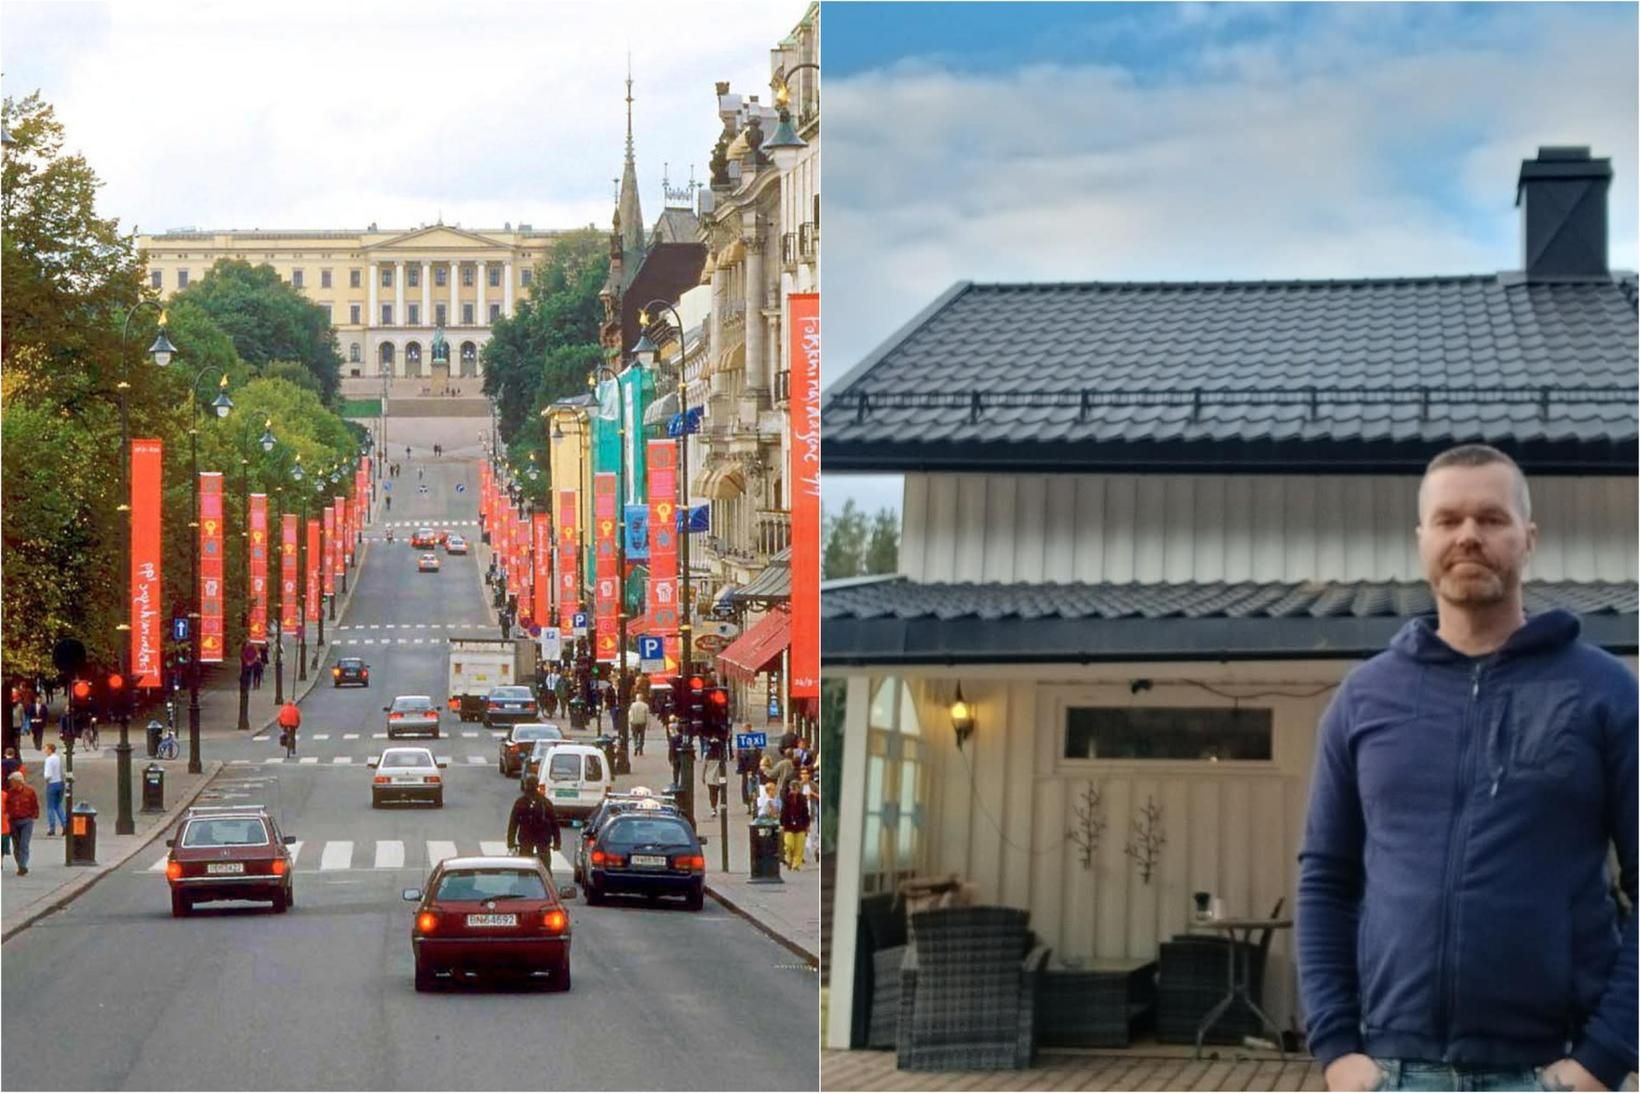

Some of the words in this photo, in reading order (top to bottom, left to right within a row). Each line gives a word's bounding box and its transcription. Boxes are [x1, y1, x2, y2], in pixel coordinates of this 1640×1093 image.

[576, 614, 585, 627] P
[645, 639, 658, 658] P
[739, 735, 762, 747] Taxi
